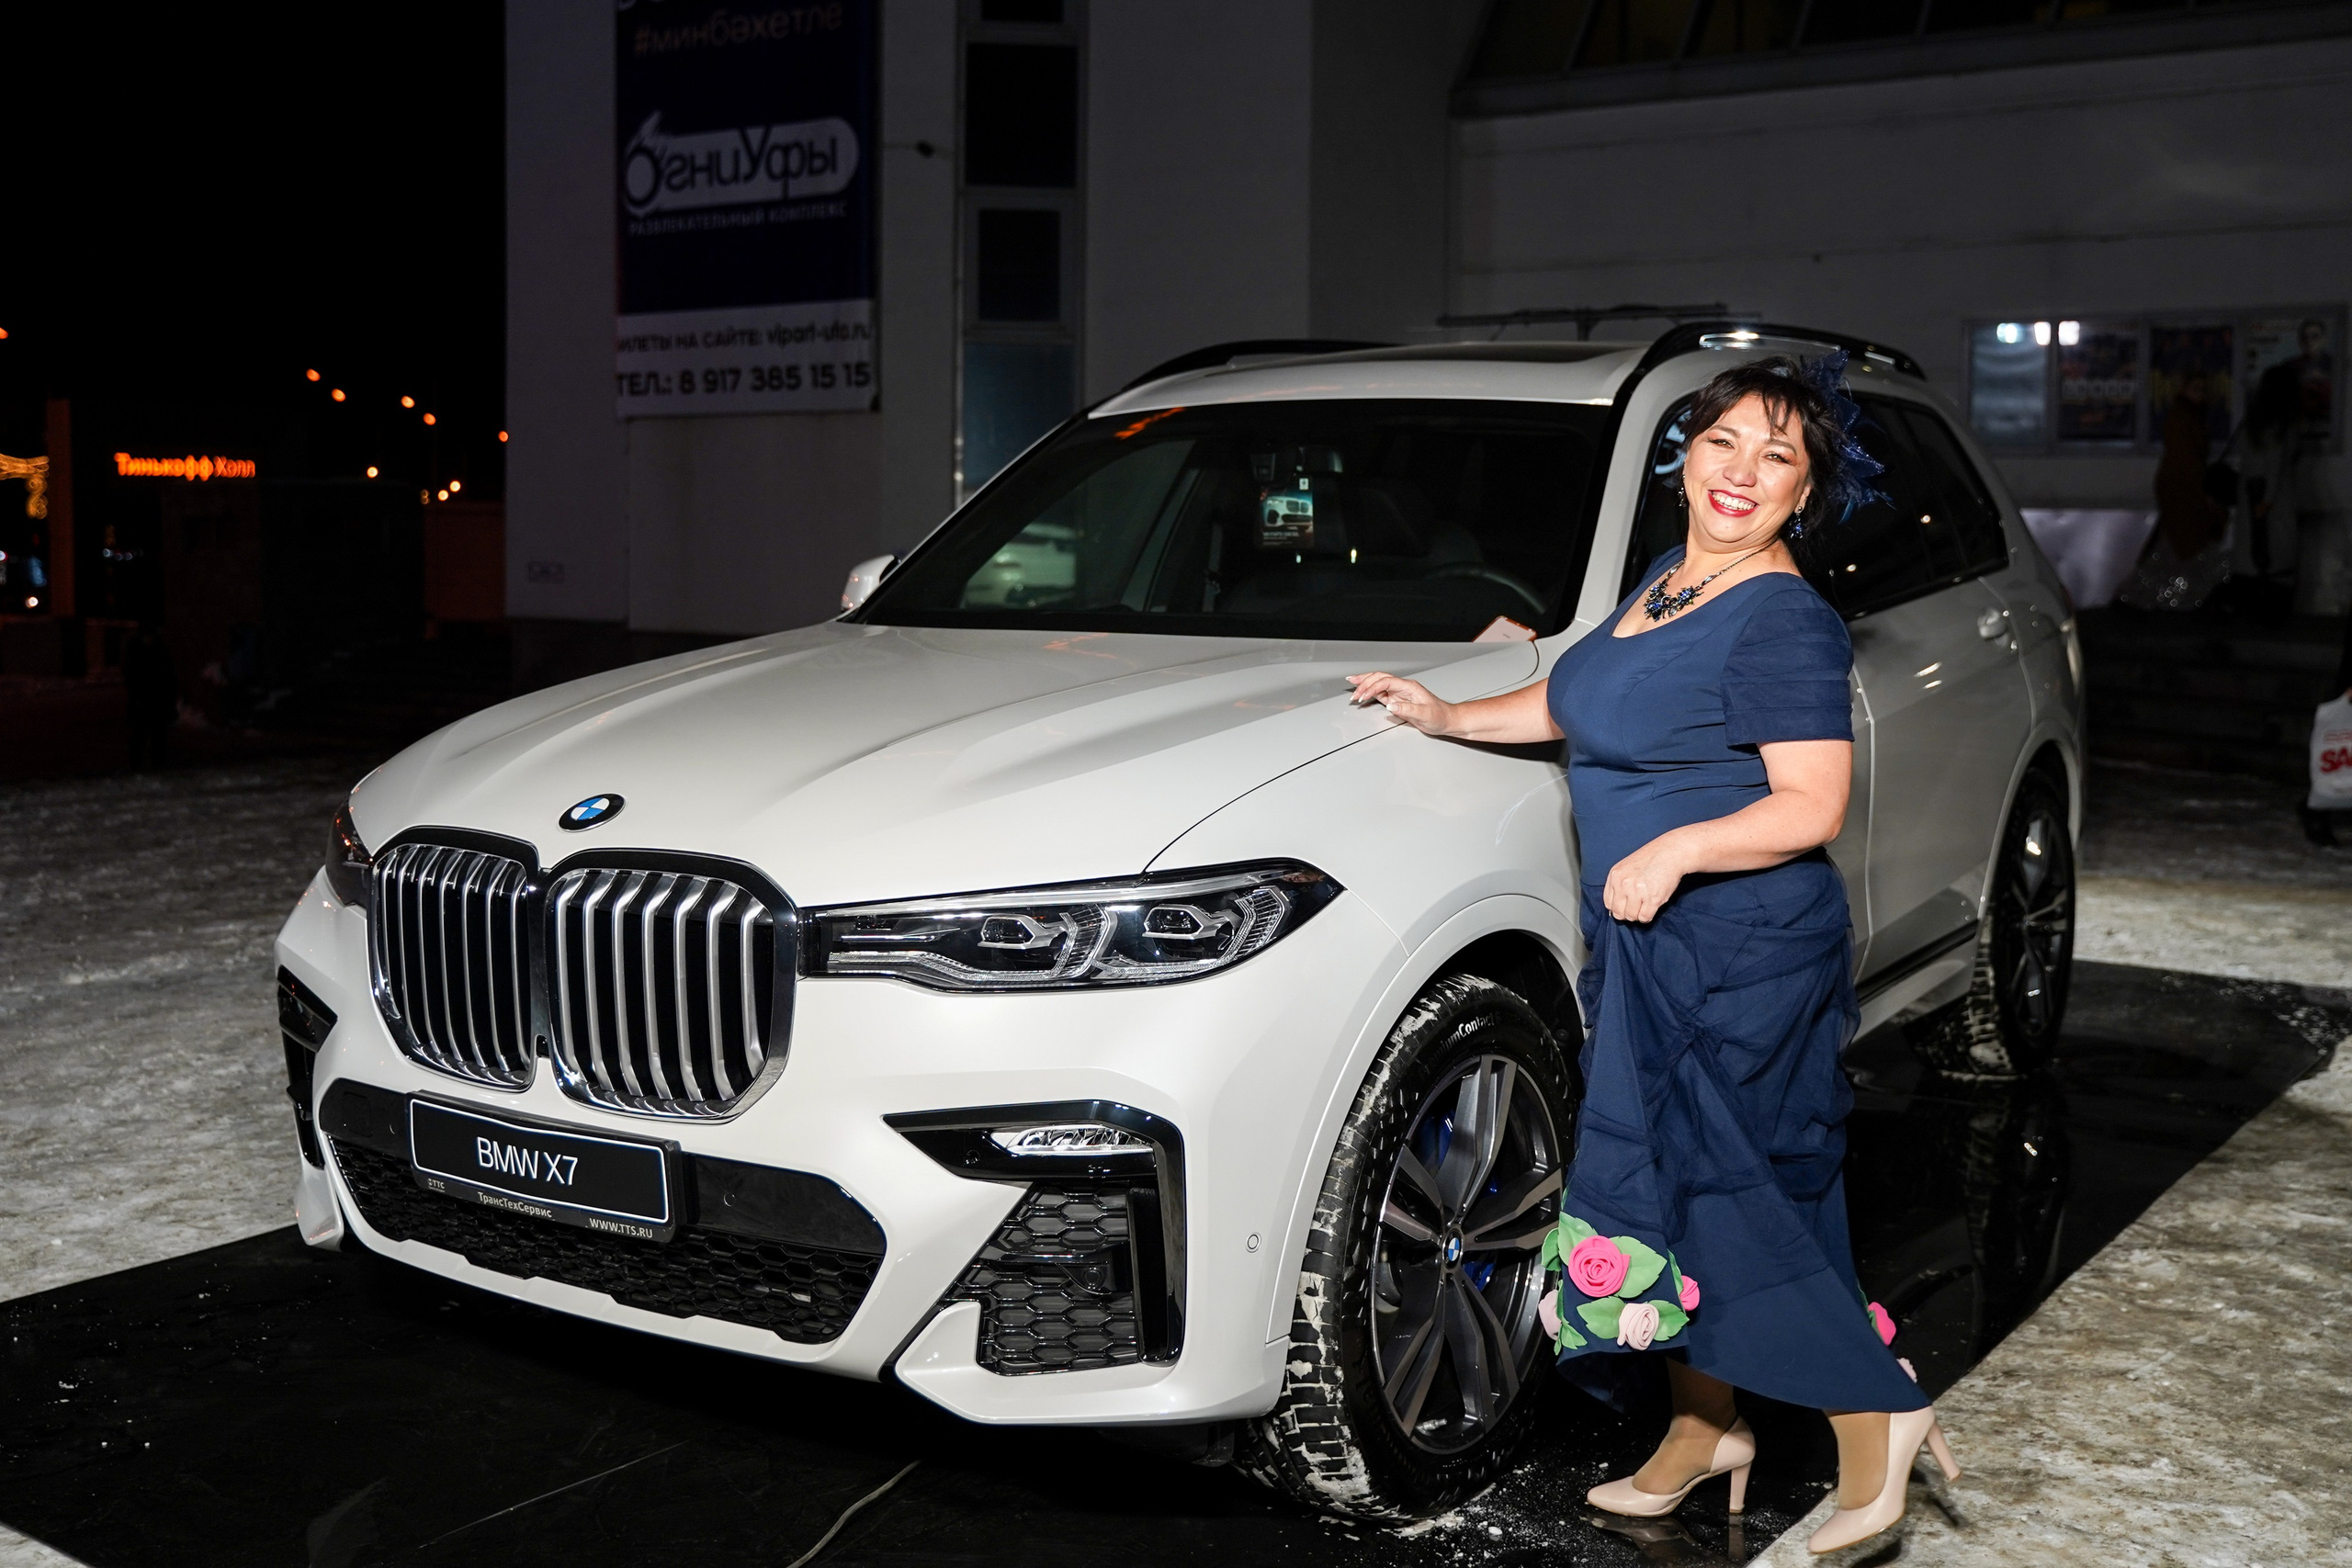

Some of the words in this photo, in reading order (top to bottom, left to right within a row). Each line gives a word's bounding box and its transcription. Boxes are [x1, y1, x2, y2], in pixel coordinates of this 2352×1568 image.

[629, 209, 765, 236] РАЗВЛЕКАТЕЛЬНЫЙ
[769, 200, 847, 223] КОМПЛЕКС
[617, 333, 672, 352] ИЛЕТЫ
[675, 332, 698, 349] НА
[703, 325, 763, 349] САЙТЕ:
[678, 368, 695, 394] 8
[703, 367, 741, 393] 917
[751, 366, 802, 392] 385
[809, 364, 837, 389] 15
[842, 363, 870, 388] 15
[113, 452, 214, 482] Тинькофф
[2320, 748, 2352, 774] SA
[477, 1136, 538, 1179] BMW
[543, 1151, 579, 1186] X7
[478, 1191, 551, 1218] ТрансТехСервис
[590, 1217, 653, 1239] WWW.TTS.RU
